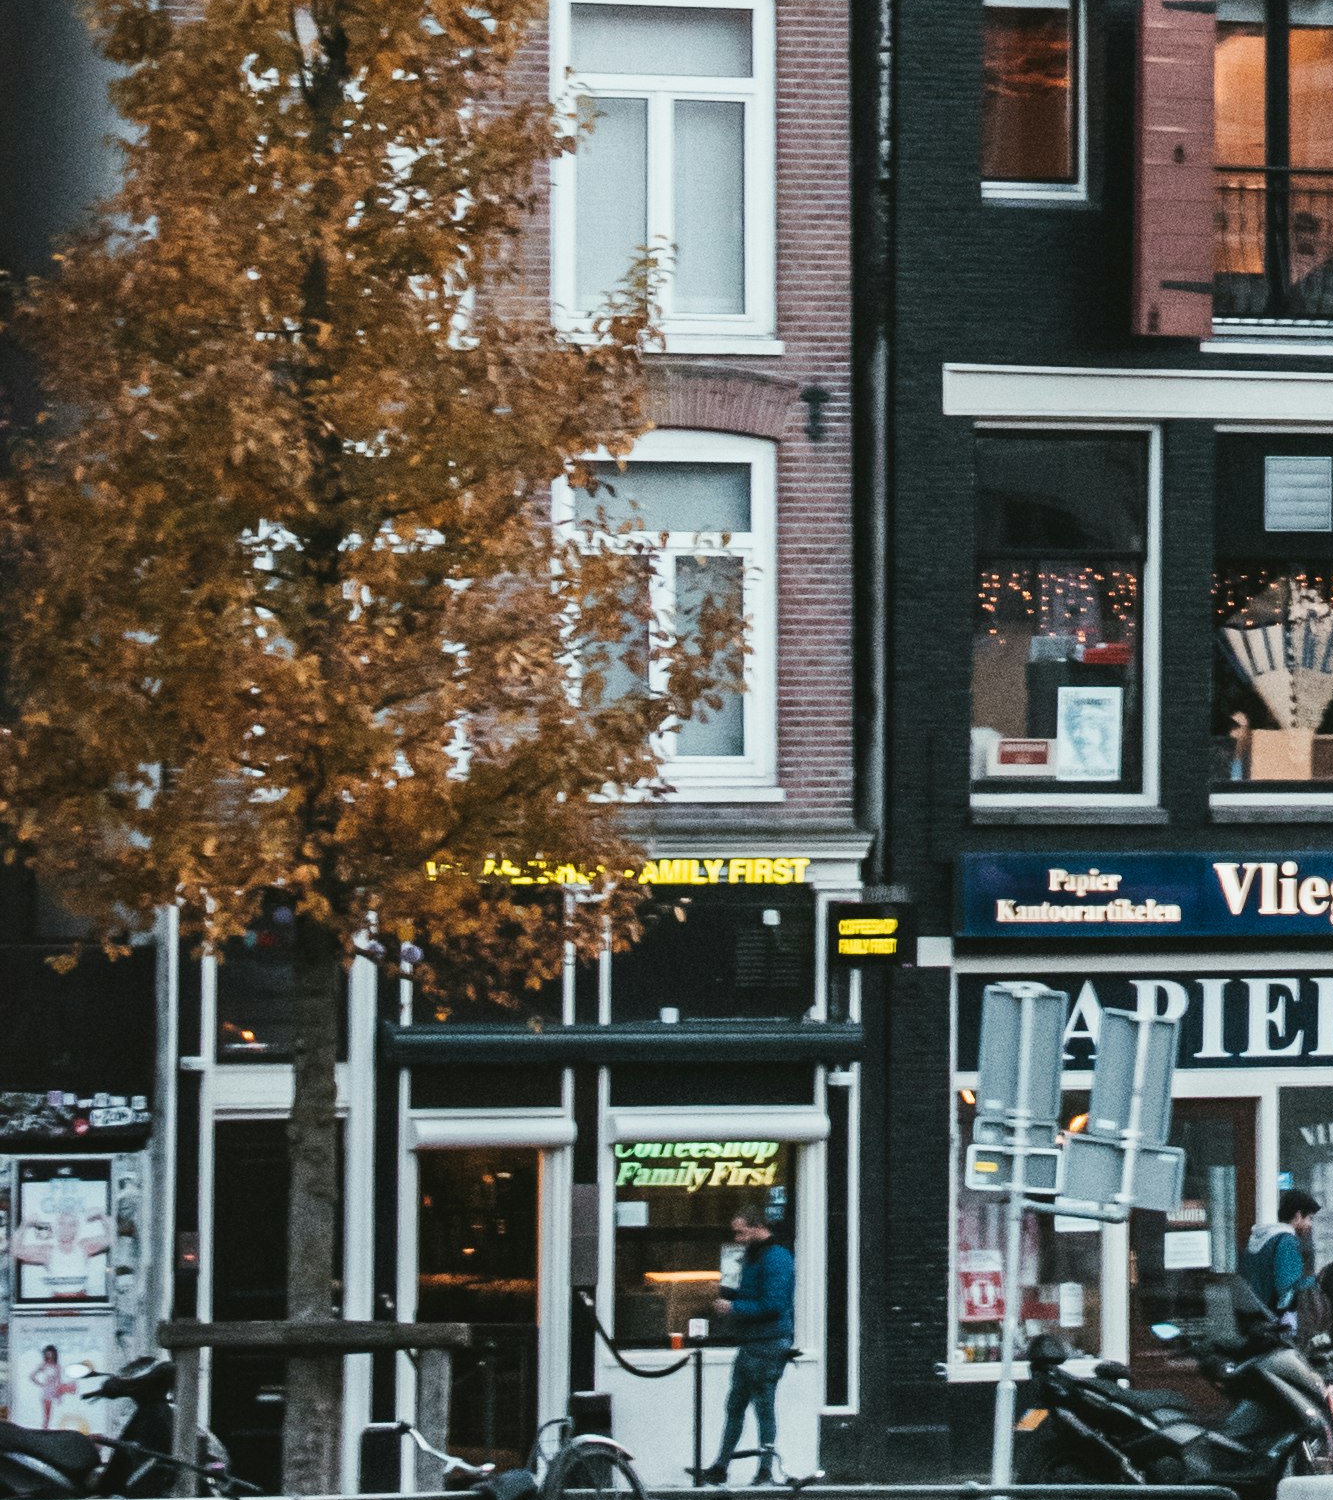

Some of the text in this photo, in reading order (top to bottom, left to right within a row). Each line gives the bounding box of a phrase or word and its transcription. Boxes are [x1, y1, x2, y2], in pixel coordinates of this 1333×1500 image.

[622, 858, 721, 885] AMILY
[727, 858, 811, 885] FIRST
[1048, 868, 1122, 897] Papier
[995, 899, 1182, 924] Kantoorartikelen
[615, 1161, 778, 1192] Family First
